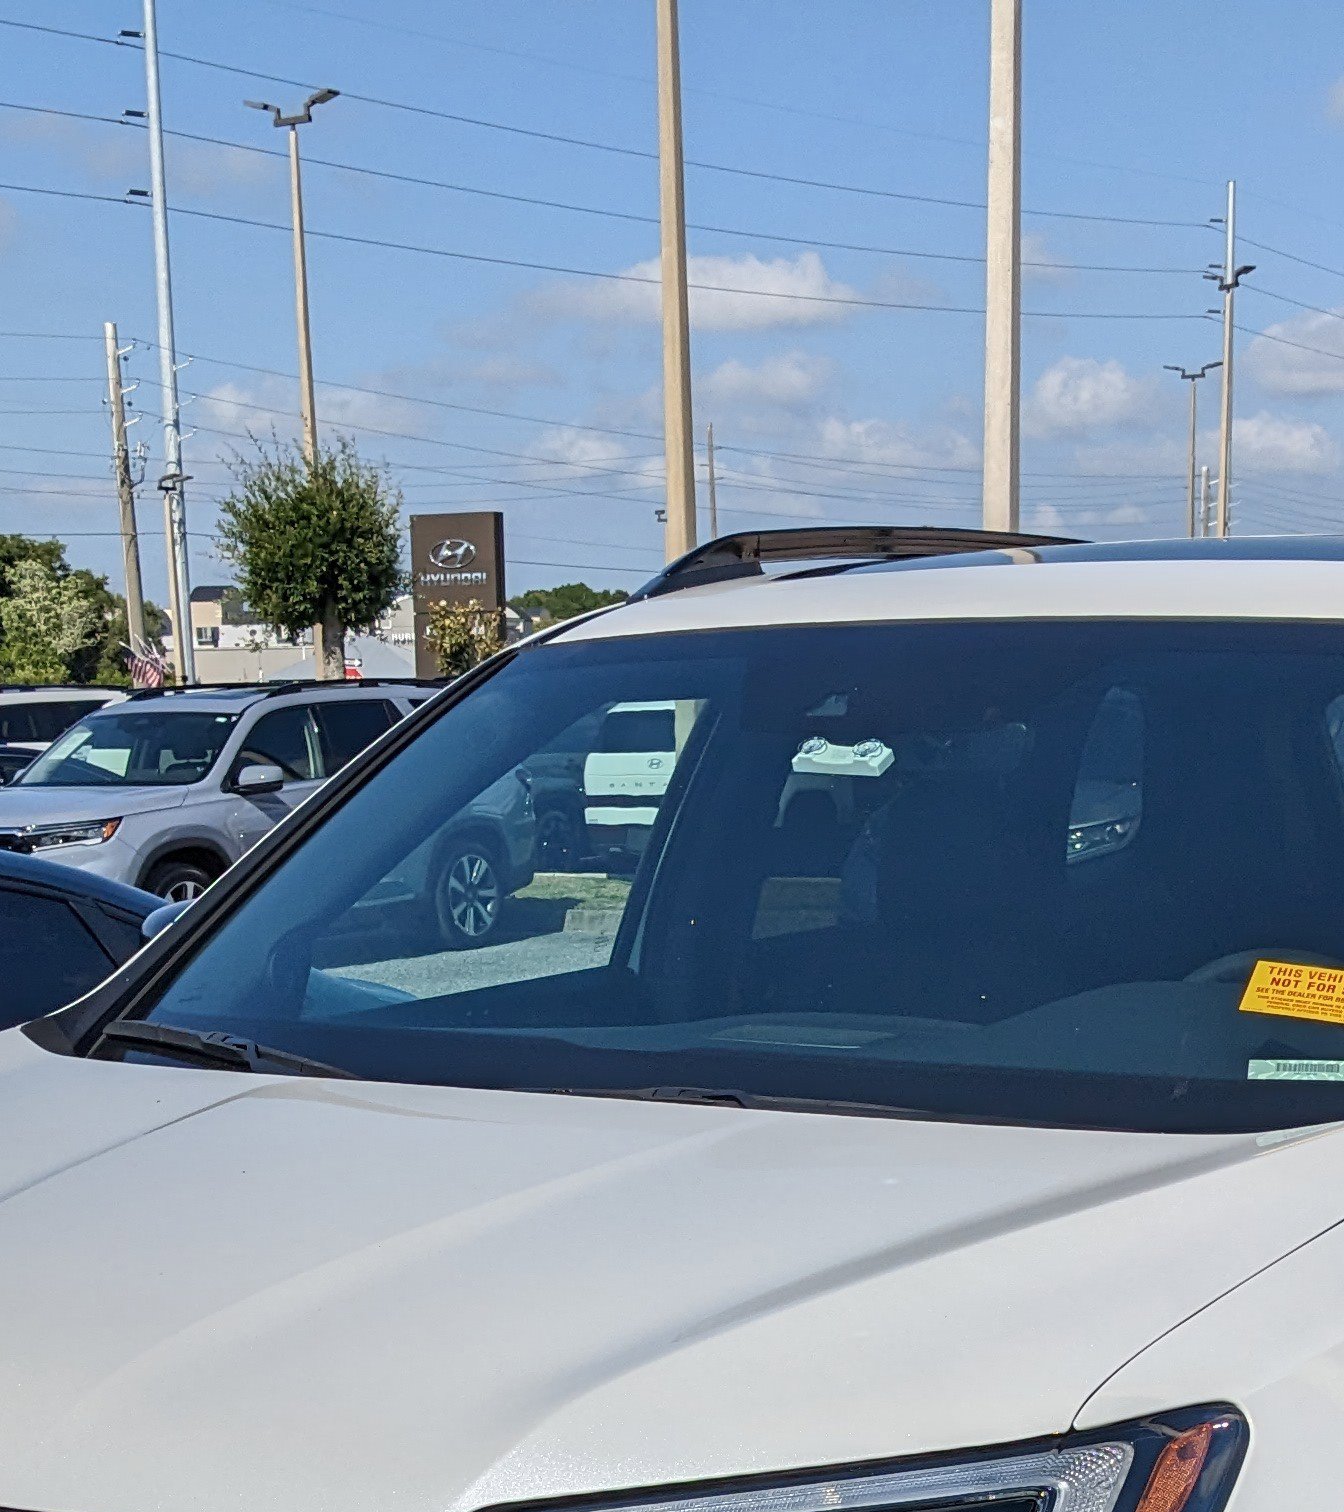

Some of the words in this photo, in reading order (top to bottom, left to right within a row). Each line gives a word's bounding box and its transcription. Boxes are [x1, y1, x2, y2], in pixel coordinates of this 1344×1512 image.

[419, 572, 487, 586] HYUNDAI
[1269, 966, 1303, 978] THIS
[1270, 977, 1302, 988] NOT
[1307, 981, 1336, 993] FOR
[1272, 988, 1286, 996] THE
[1287, 990, 1316, 999] DEALER
[1318, 994, 1333, 1002] FOR
